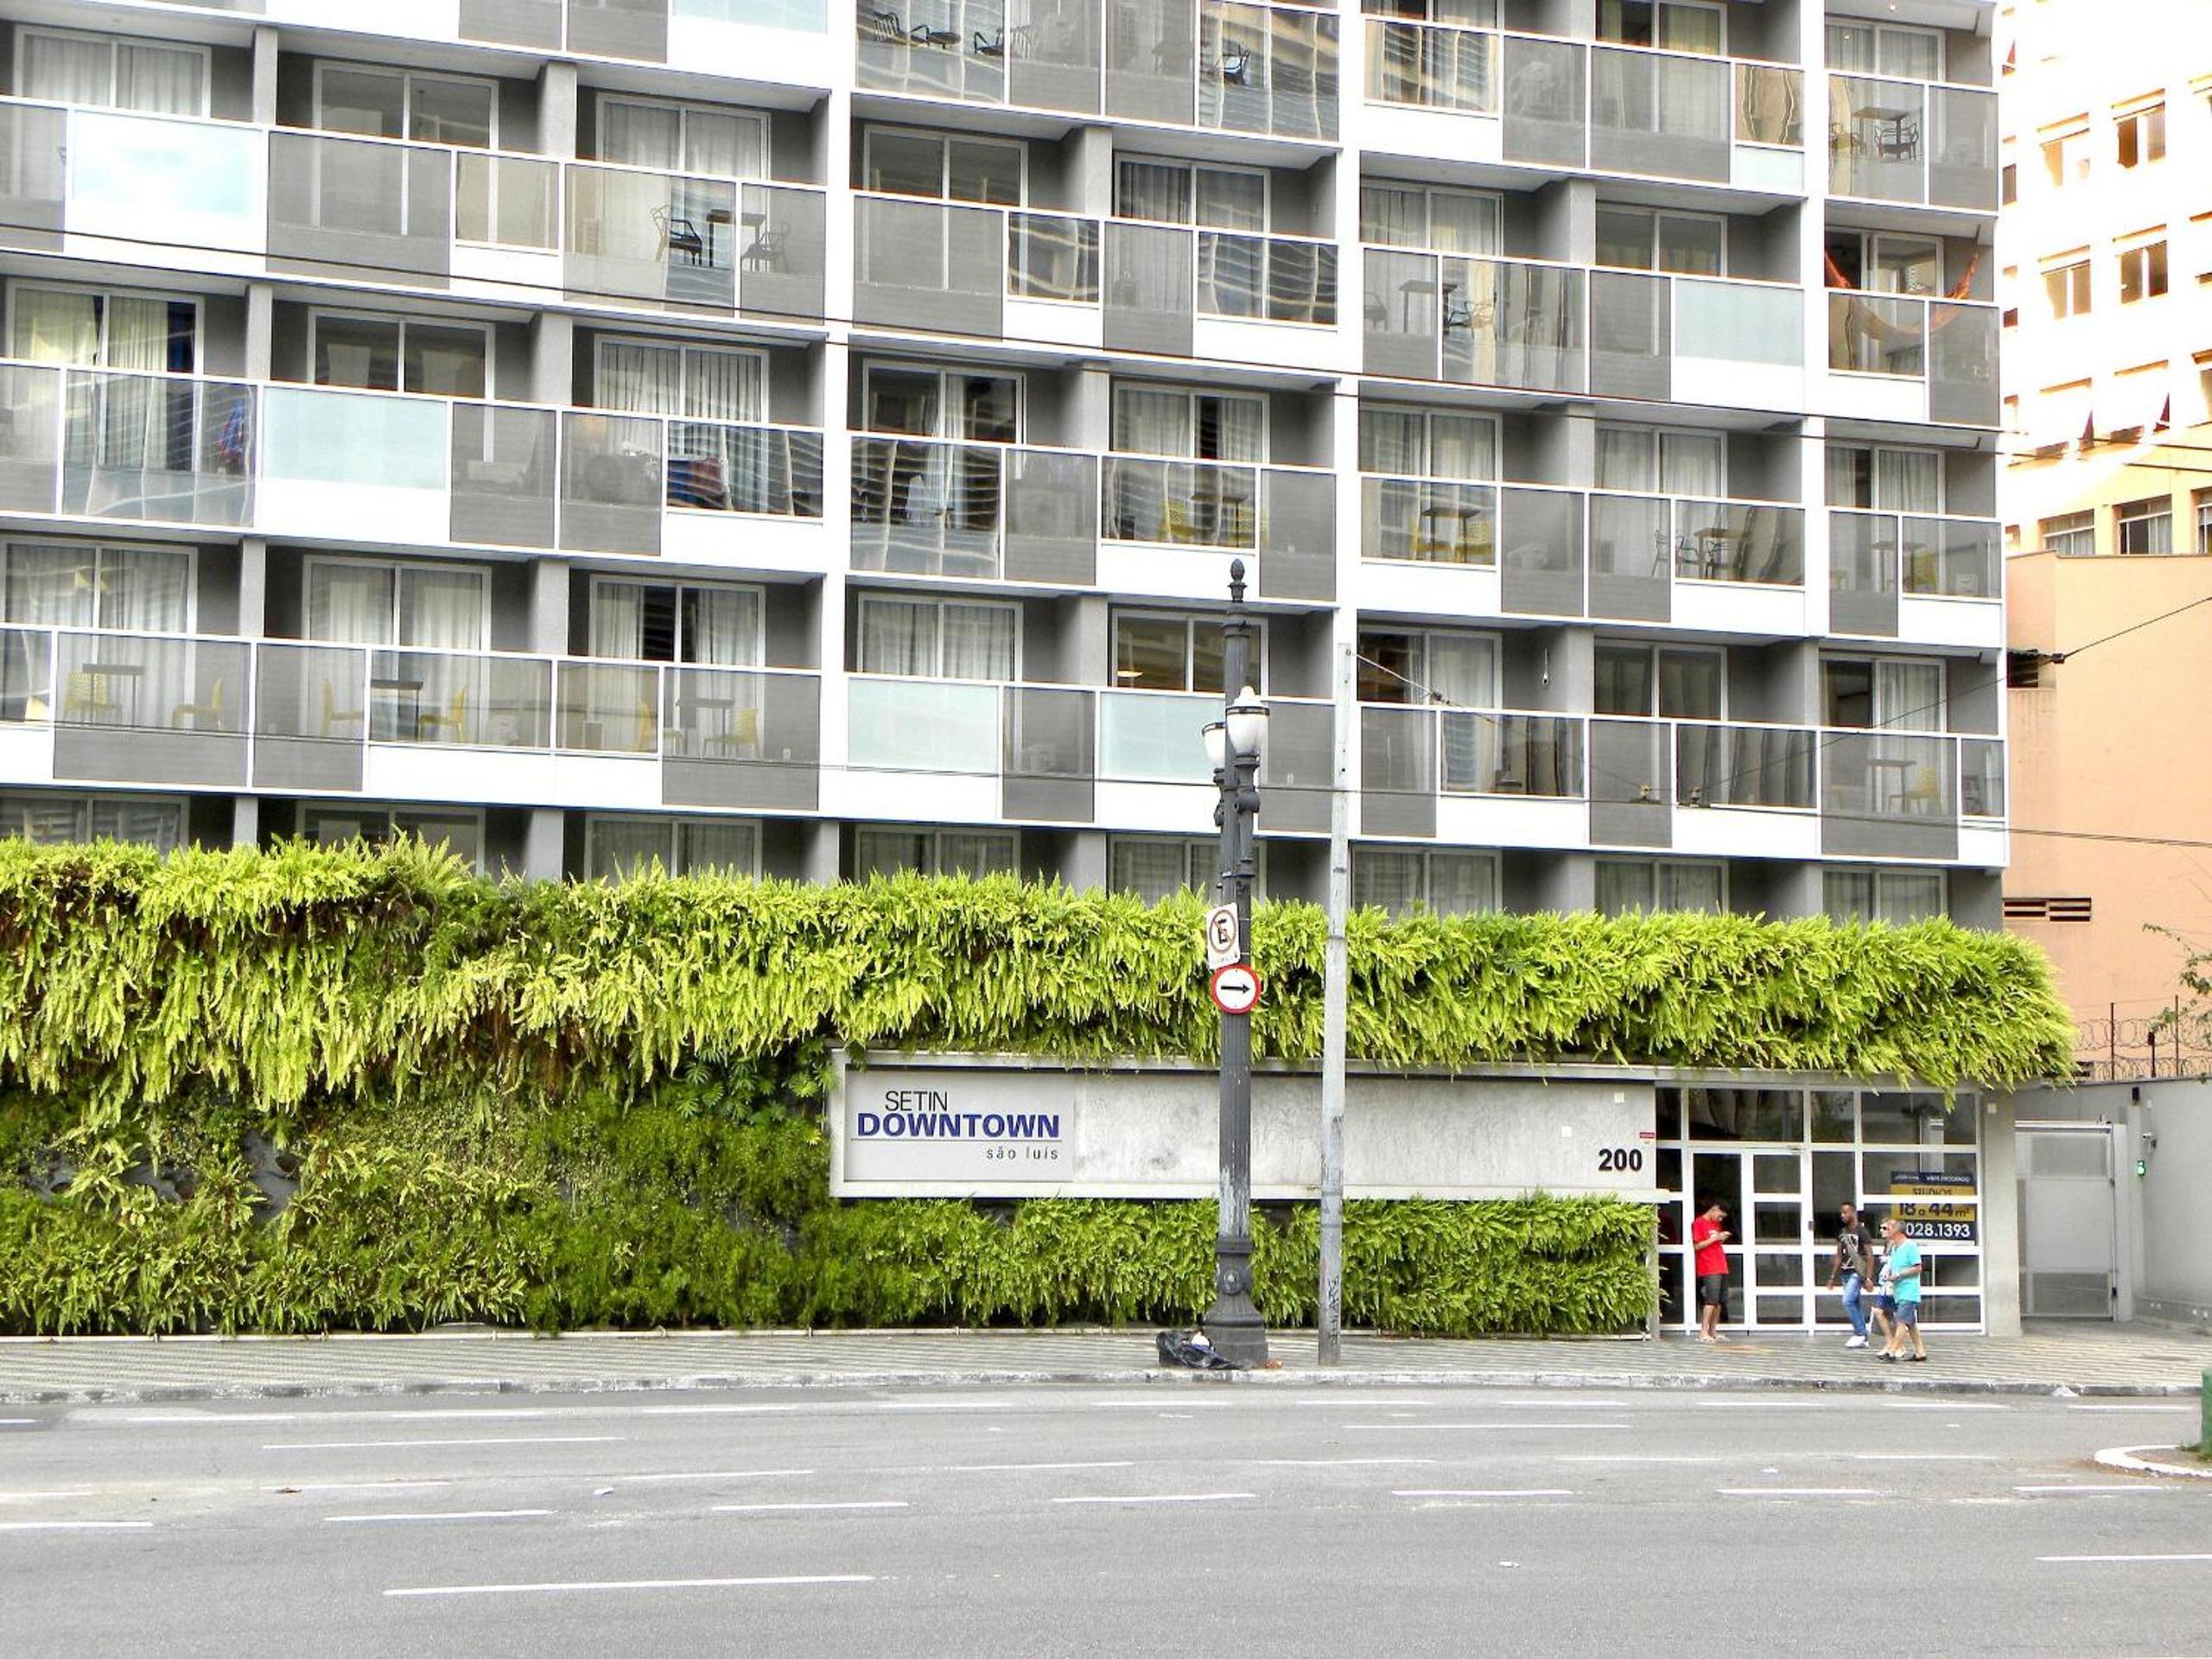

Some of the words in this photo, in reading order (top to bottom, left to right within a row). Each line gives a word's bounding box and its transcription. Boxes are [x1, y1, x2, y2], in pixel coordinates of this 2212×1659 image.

[885, 1090, 948, 1112] SETIN
[857, 1113, 1059, 1138] DOWNTOWN
[986, 1146, 1017, 1160] são
[1026, 1146, 1058, 1160] luís
[1599, 1148, 1643, 1171] 200
[1899, 1203, 1916, 1217] 18
[1929, 1203, 1953, 1217] 44
[1955, 1206, 1970, 1217] m²
[1905, 1223, 1971, 1238] 028.1393
